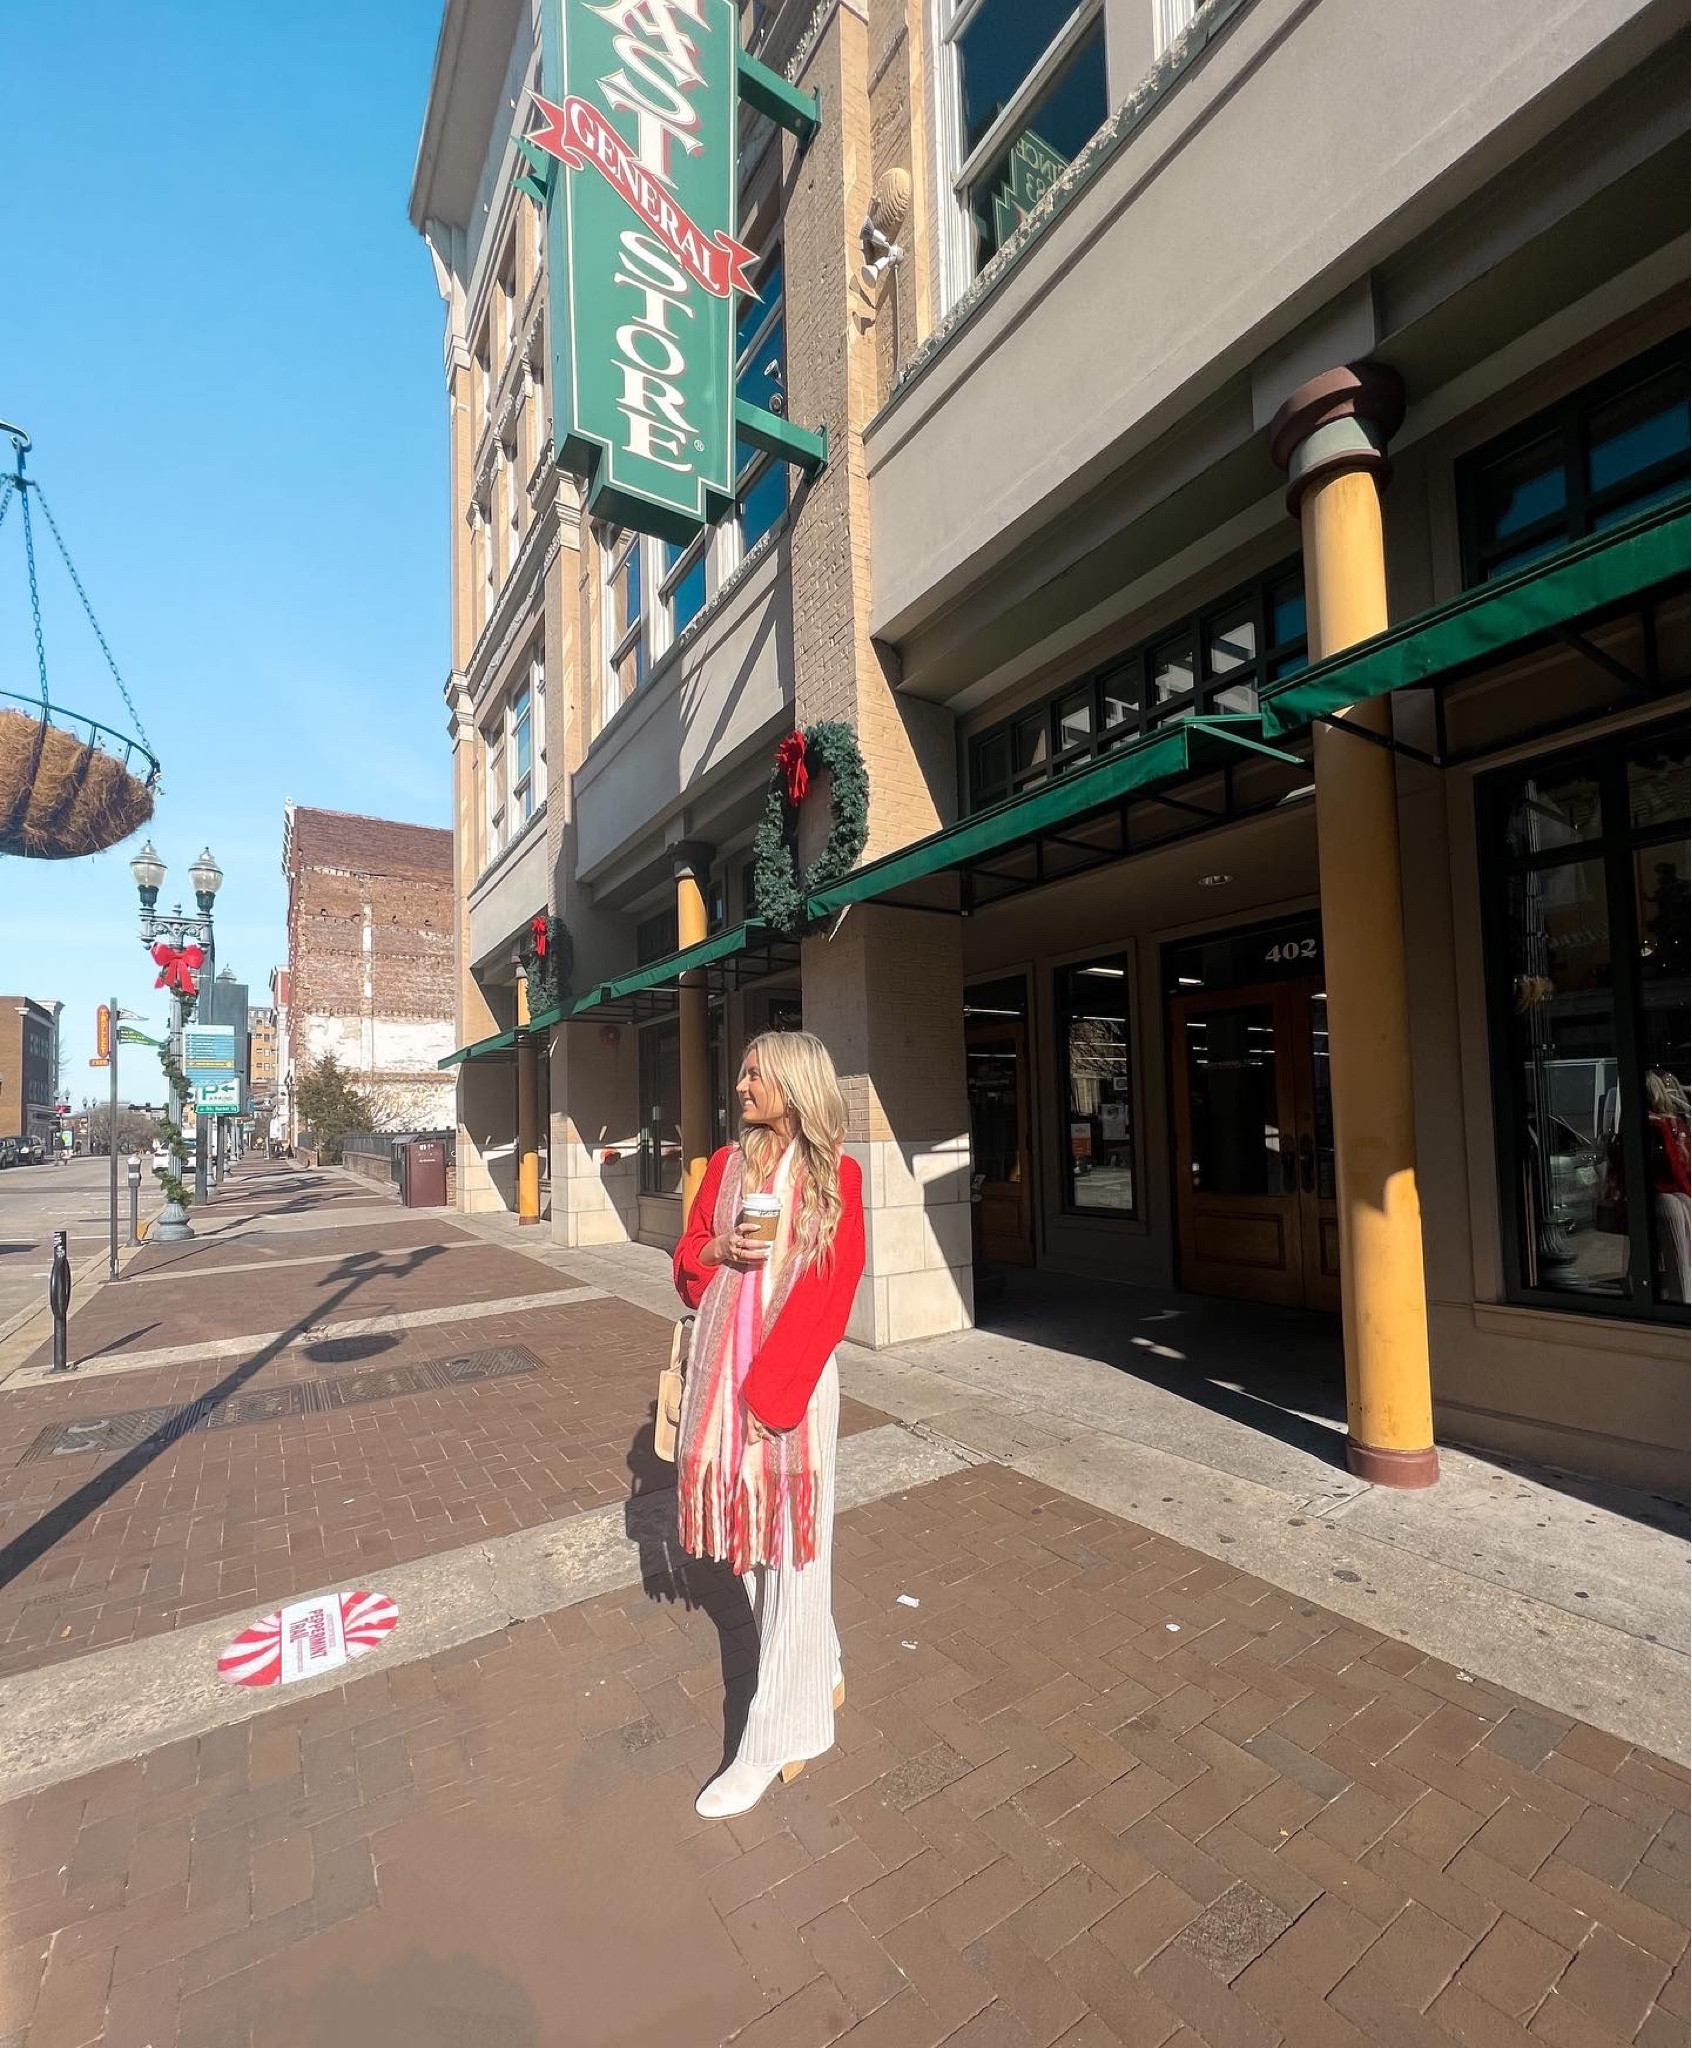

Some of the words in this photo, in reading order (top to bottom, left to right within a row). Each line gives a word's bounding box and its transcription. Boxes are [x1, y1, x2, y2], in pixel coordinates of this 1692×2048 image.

[579, 0, 712, 190] AST
[570, 102, 722, 292] GENERAL
[610, 229, 698, 473] STORE
[1265, 939, 1317, 962] 402
[290, 1617, 309, 1644] TRAIL
[309, 1608, 328, 1660] PEPPERMINT
